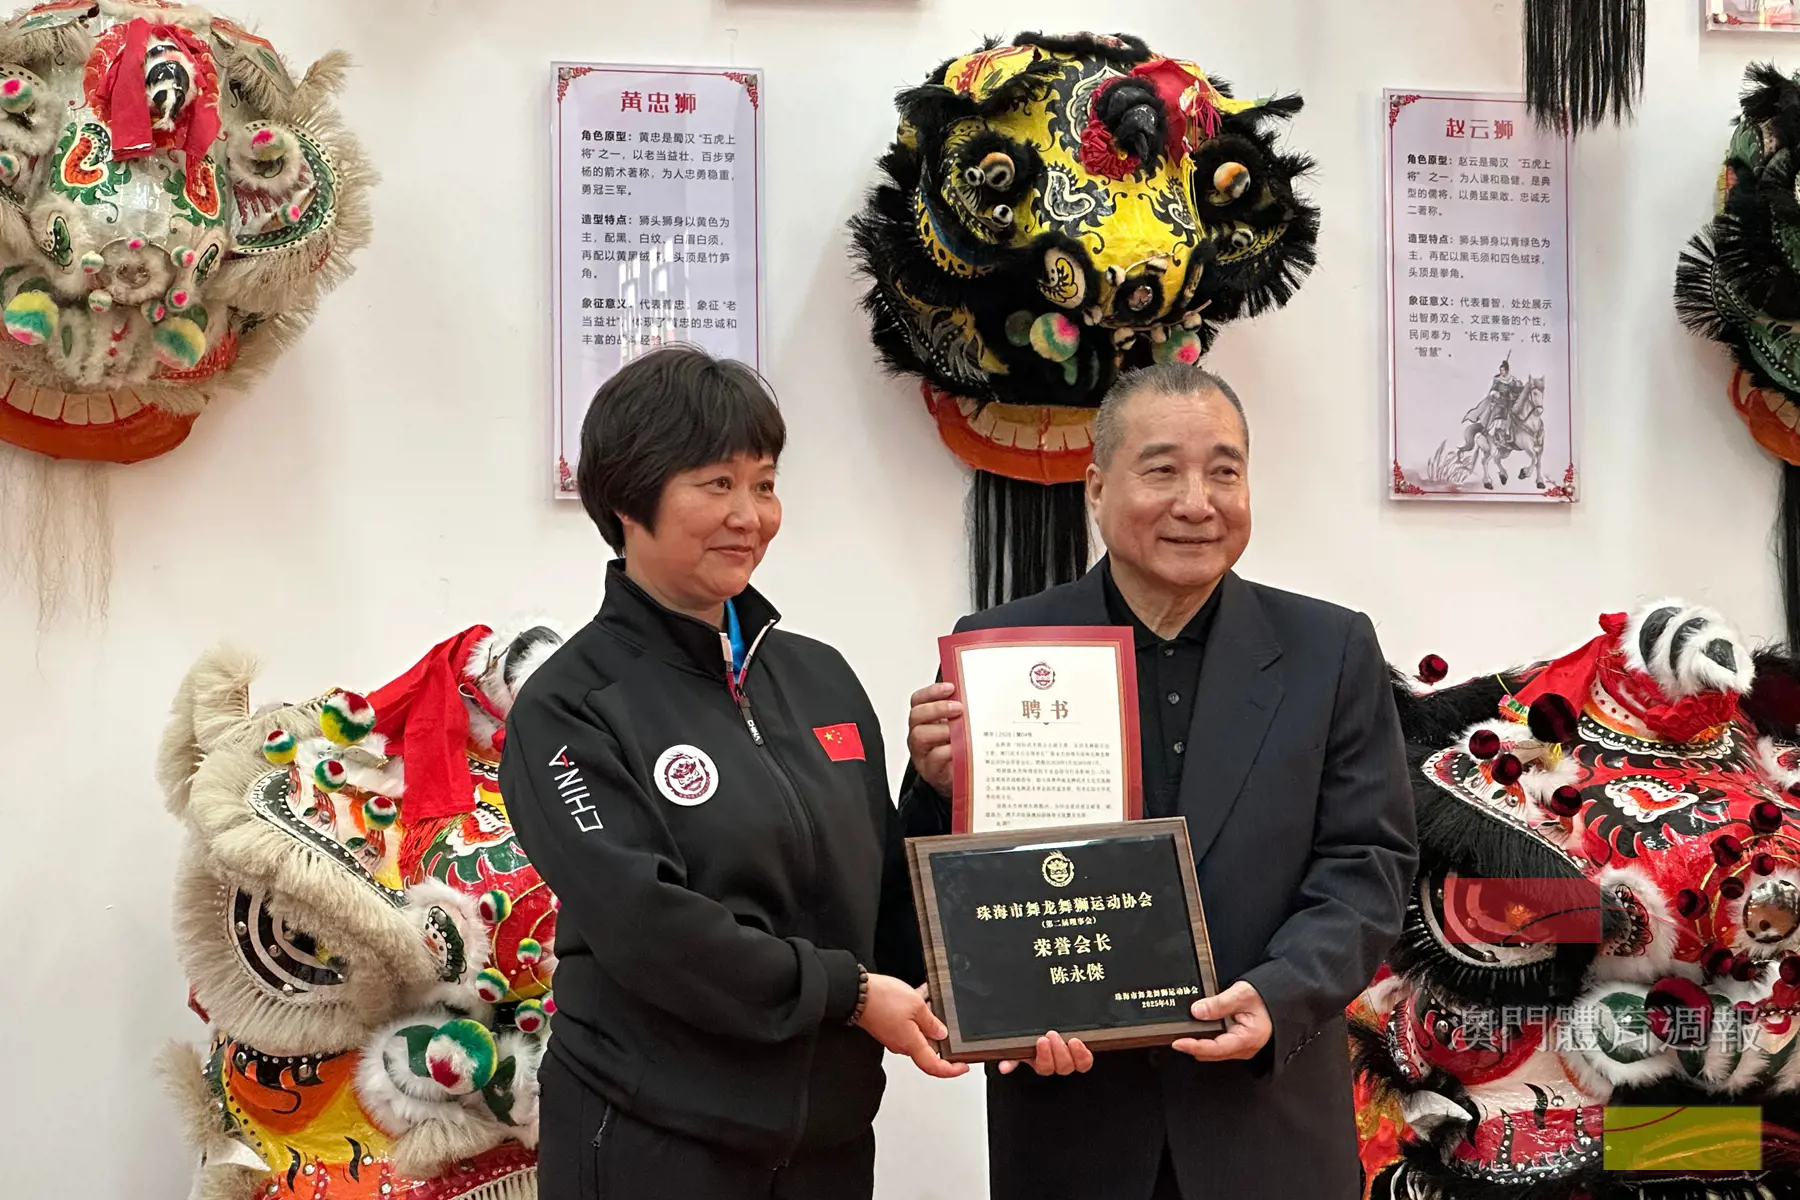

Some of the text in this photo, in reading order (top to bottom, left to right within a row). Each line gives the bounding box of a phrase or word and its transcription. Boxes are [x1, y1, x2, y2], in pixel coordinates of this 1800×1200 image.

[621, 91, 697, 114] 黄忠狮
[1446, 118, 1514, 140] 赵云狮
[581, 184, 632, 196] 勇冠三军。
[1407, 205, 1442, 216] 二著称。
[581, 268, 598, 279] 角。
[1022, 699, 1069, 720] 聘书
[548, 745, 604, 832] CHINA
[975, 891, 1153, 922] 珠海市舞龙舞狮运动协会
[1033, 932, 1112, 958] 荣誉会长
[1049, 962, 1106, 985] 陈永傑
[1114, 985, 1199, 1001] 珠海市舞龙舞狮运动协会
